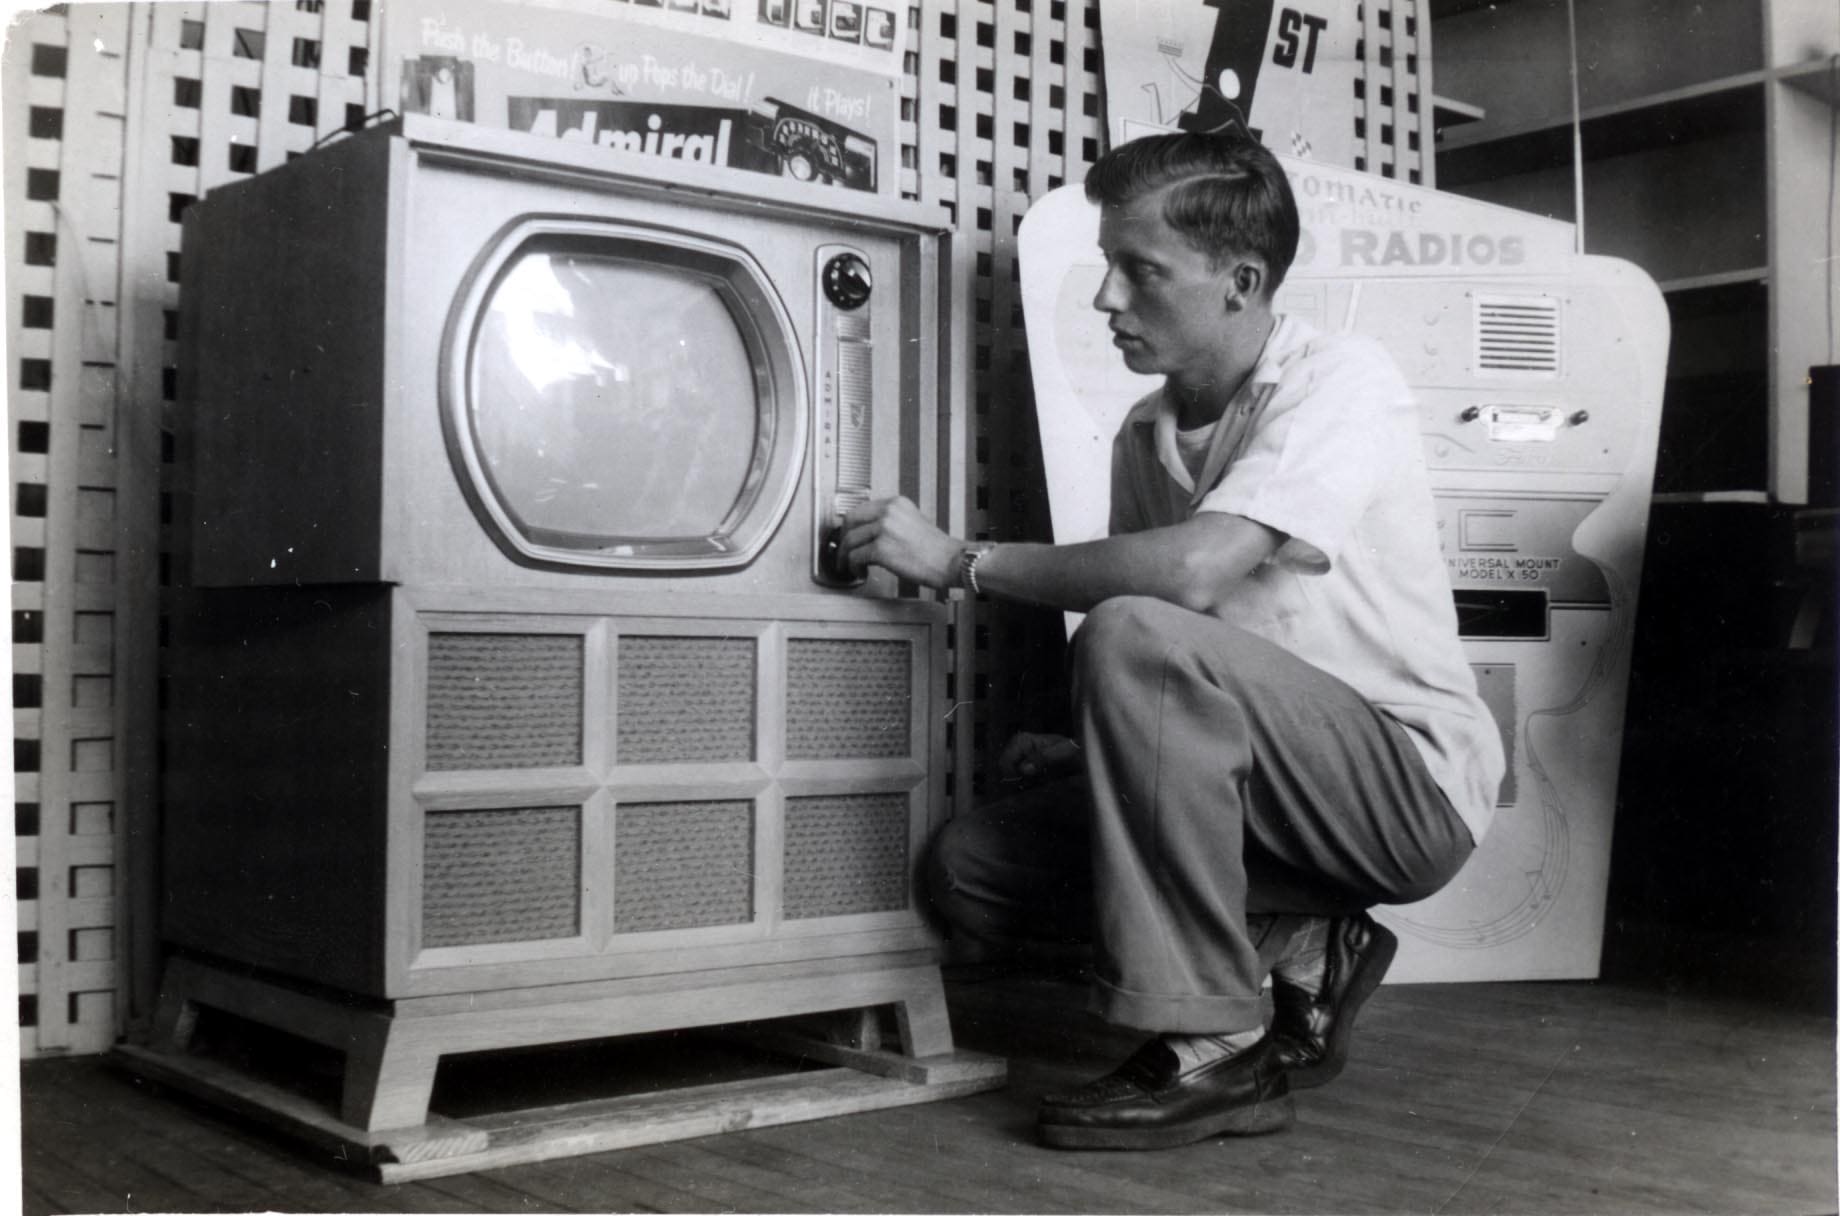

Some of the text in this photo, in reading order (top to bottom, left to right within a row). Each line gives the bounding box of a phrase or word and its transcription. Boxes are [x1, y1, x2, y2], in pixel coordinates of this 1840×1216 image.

[472, 32, 501, 62] the
[1272, 7, 1328, 75] ST
[641, 54, 679, 94] Pops
[681, 62, 707, 92] the
[529, 109, 732, 167] Admiral
[1340, 228, 1526, 266] RADIOS
[1446, 558, 1560, 569] NIVERSAL MOUNT
[1459, 568, 1503, 580] MODEL
[1507, 569, 1516, 579] X
